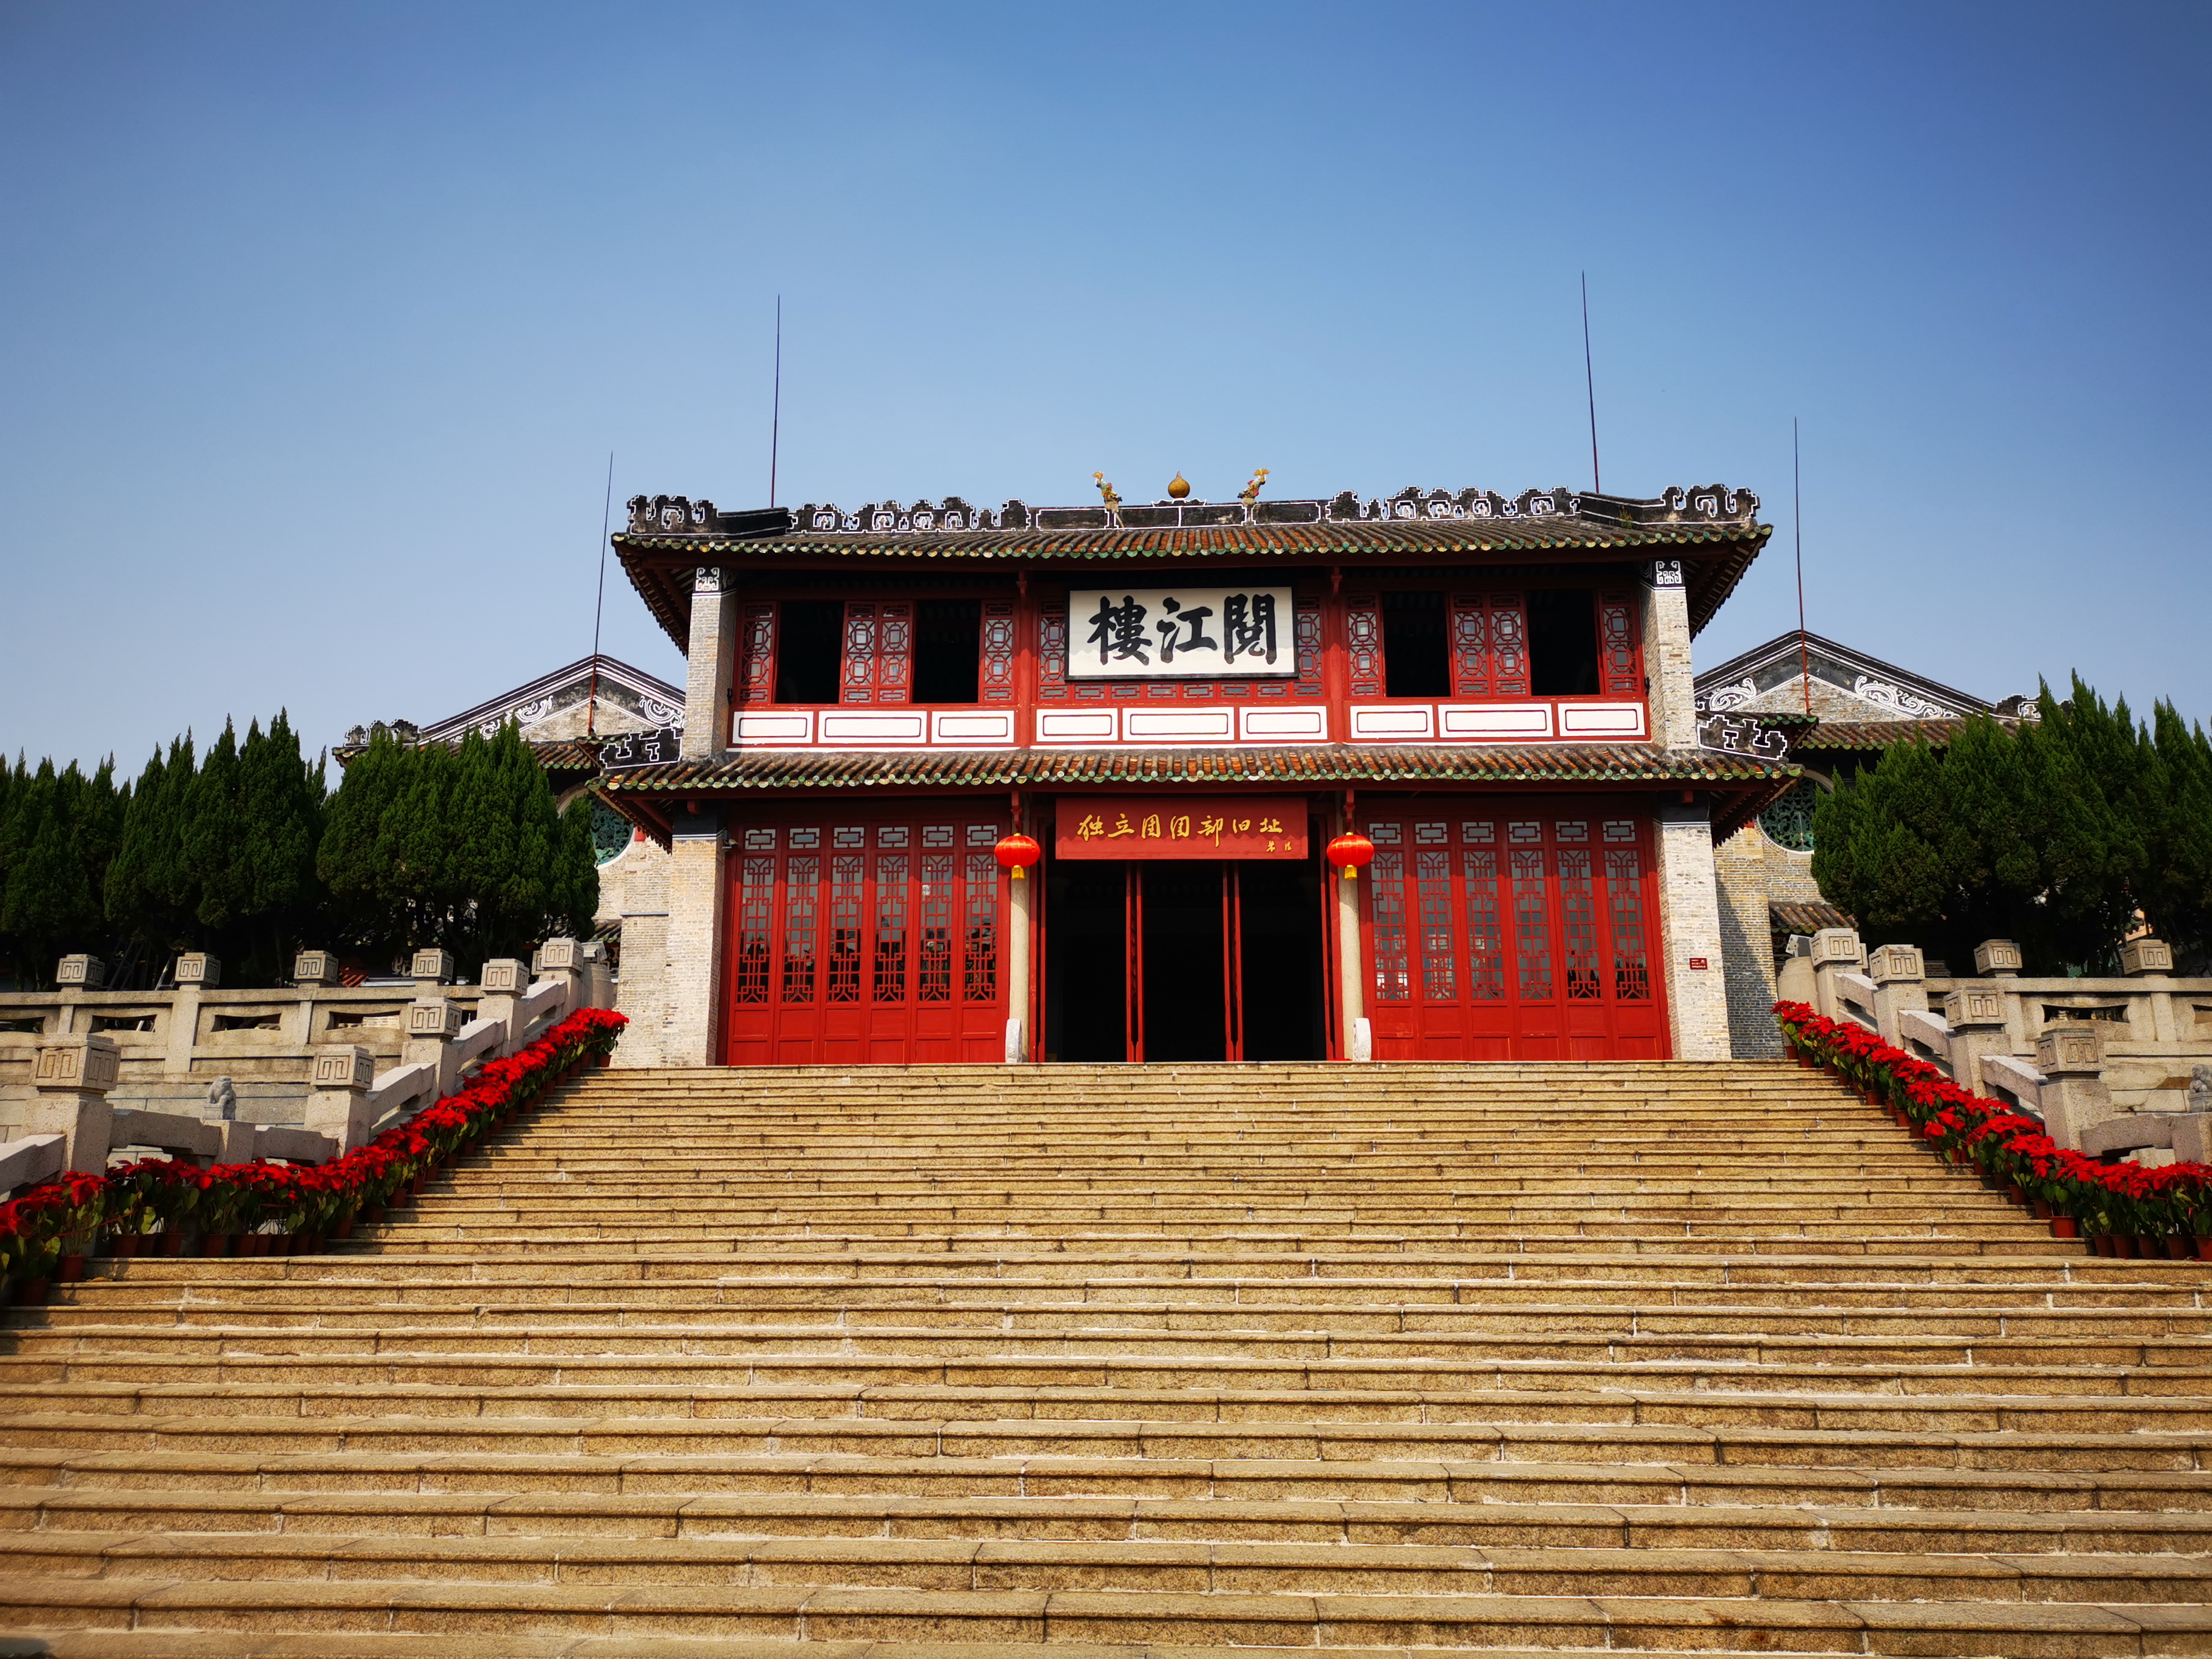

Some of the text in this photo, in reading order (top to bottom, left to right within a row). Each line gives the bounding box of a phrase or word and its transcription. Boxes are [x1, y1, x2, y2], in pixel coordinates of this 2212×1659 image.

[1077, 813, 1283, 847] 独立团团部旧址
